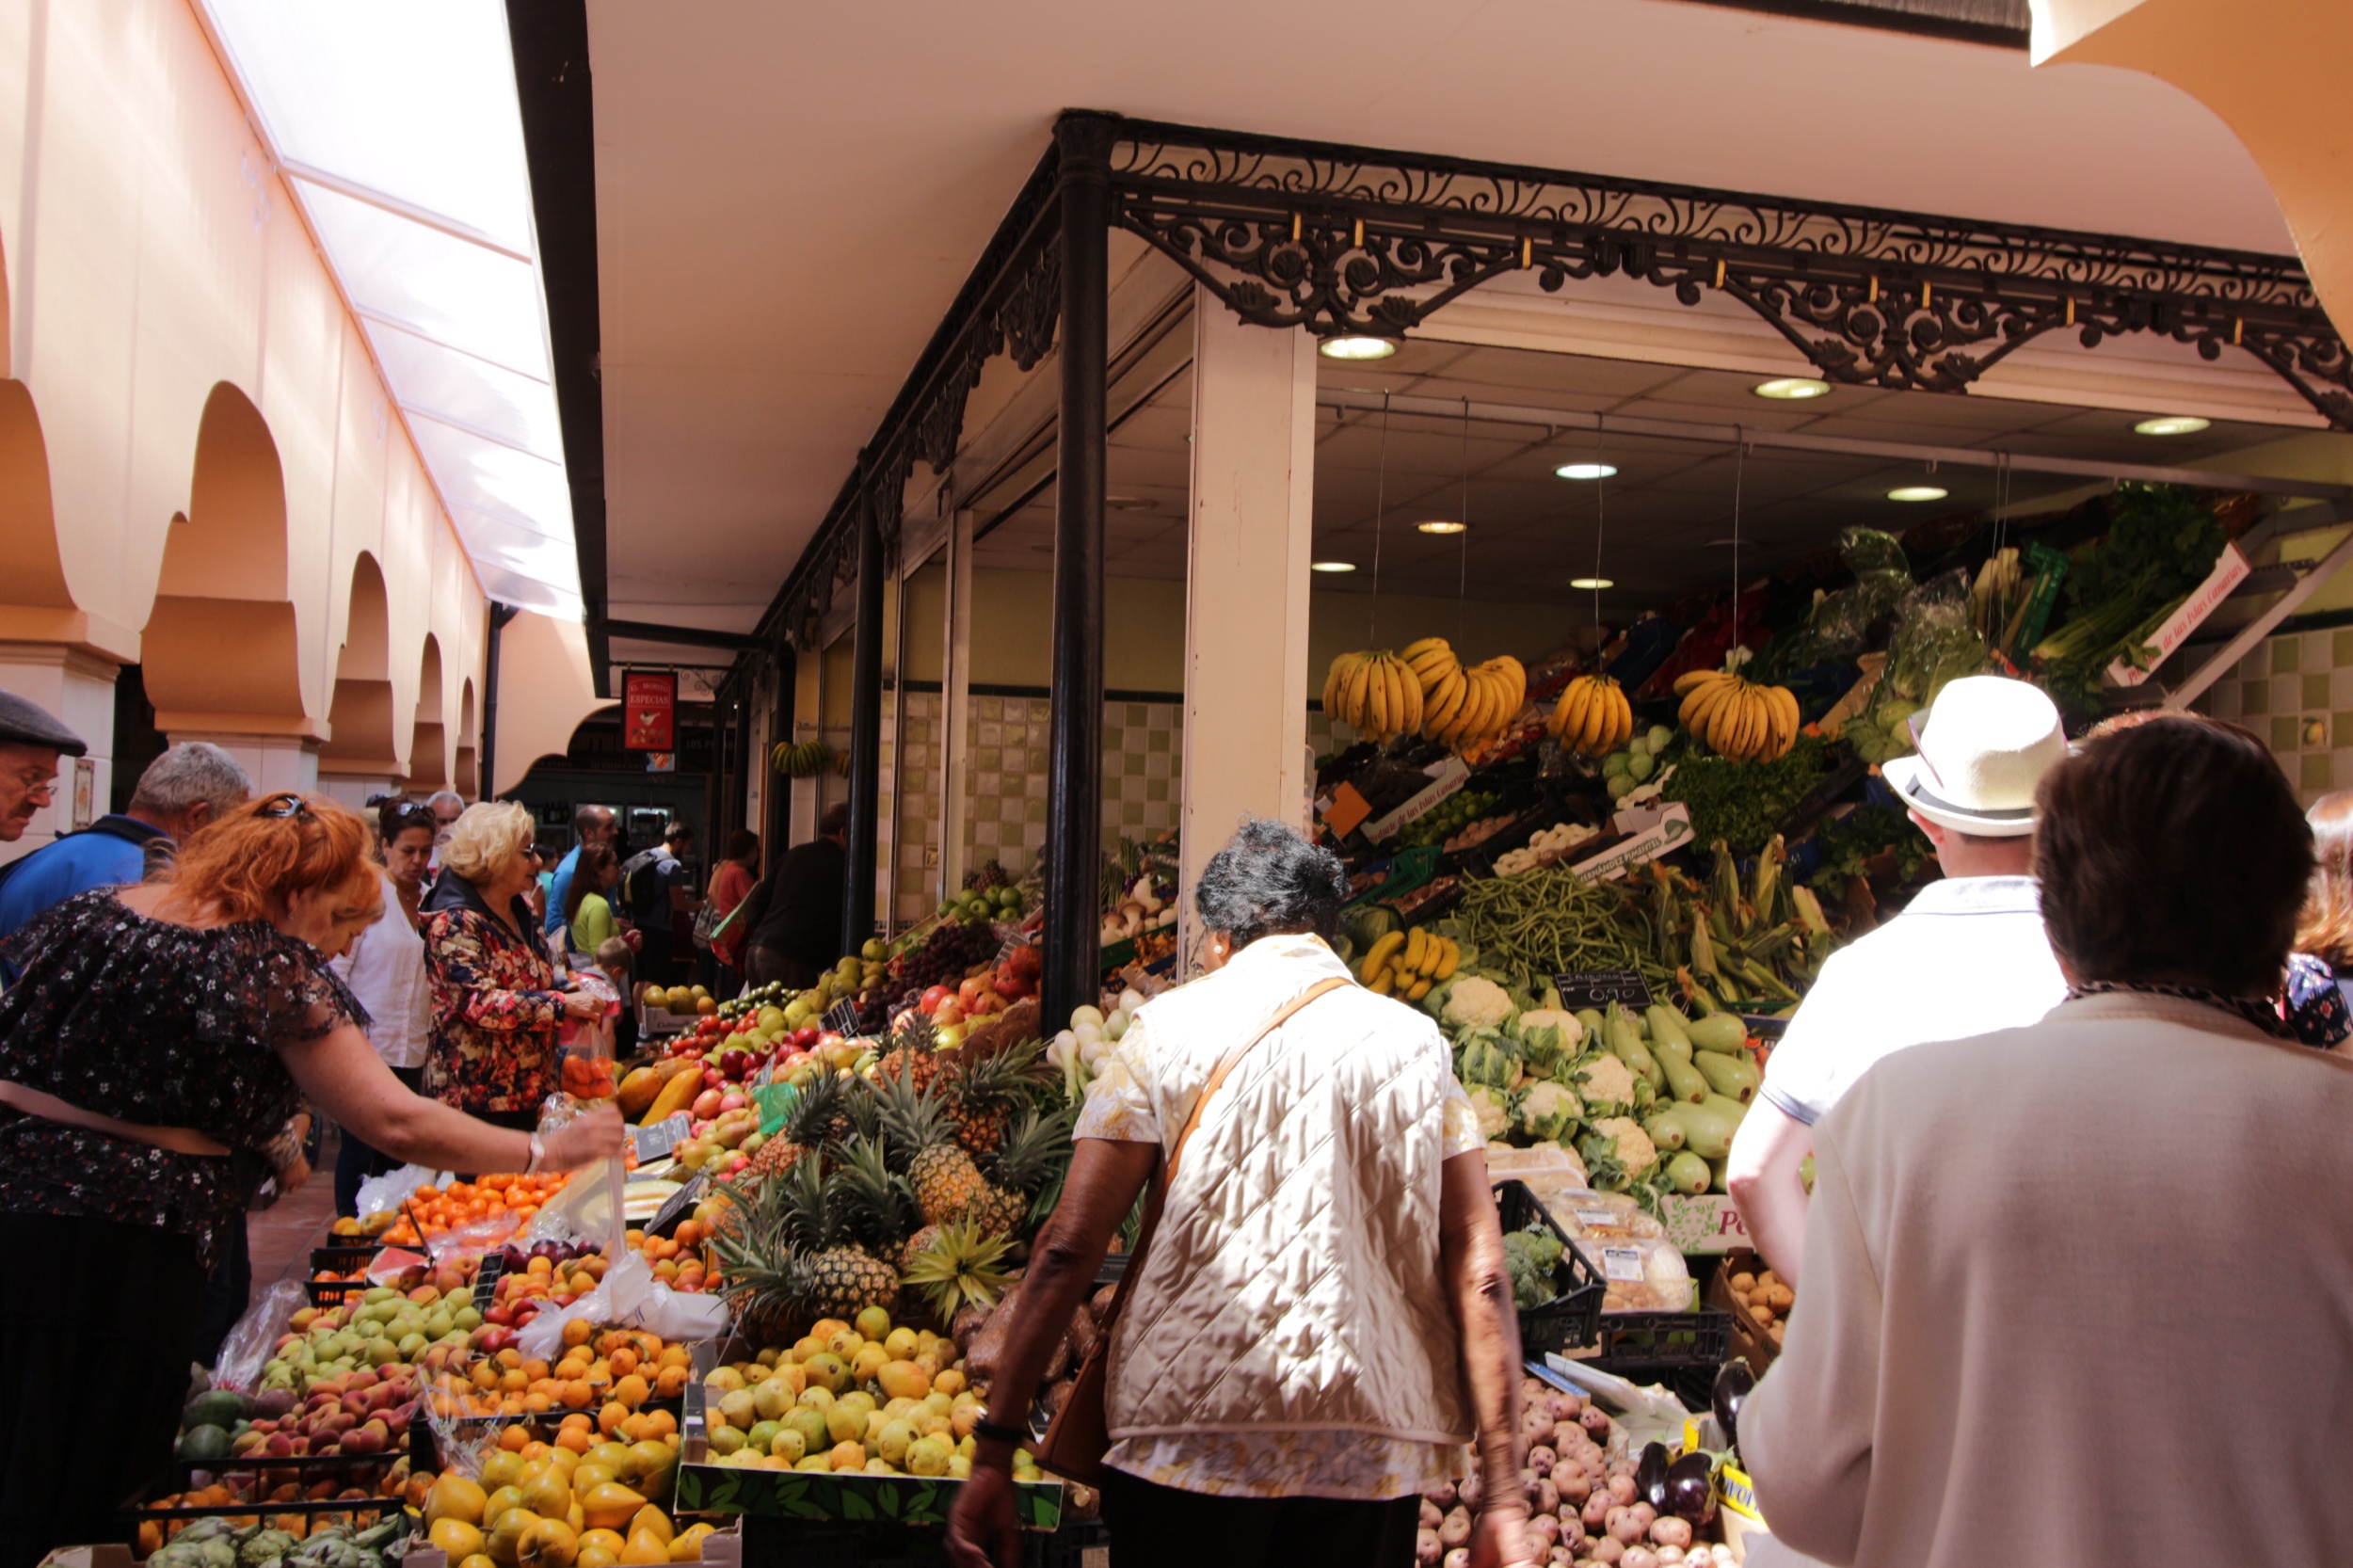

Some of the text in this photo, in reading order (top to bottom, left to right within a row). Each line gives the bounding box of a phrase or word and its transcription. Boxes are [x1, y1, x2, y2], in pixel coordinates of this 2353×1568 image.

[2163, 563, 2243, 649] de las Islas Canarias
[630, 695, 669, 705] ESPECIAS
[1397, 814, 1406, 825] de
[1407, 807, 1419, 819] las
[1418, 795, 1437, 810] Islas
[1436, 772, 1468, 797] Canarias
[1624, 837, 1662, 863] PIMENTEL
